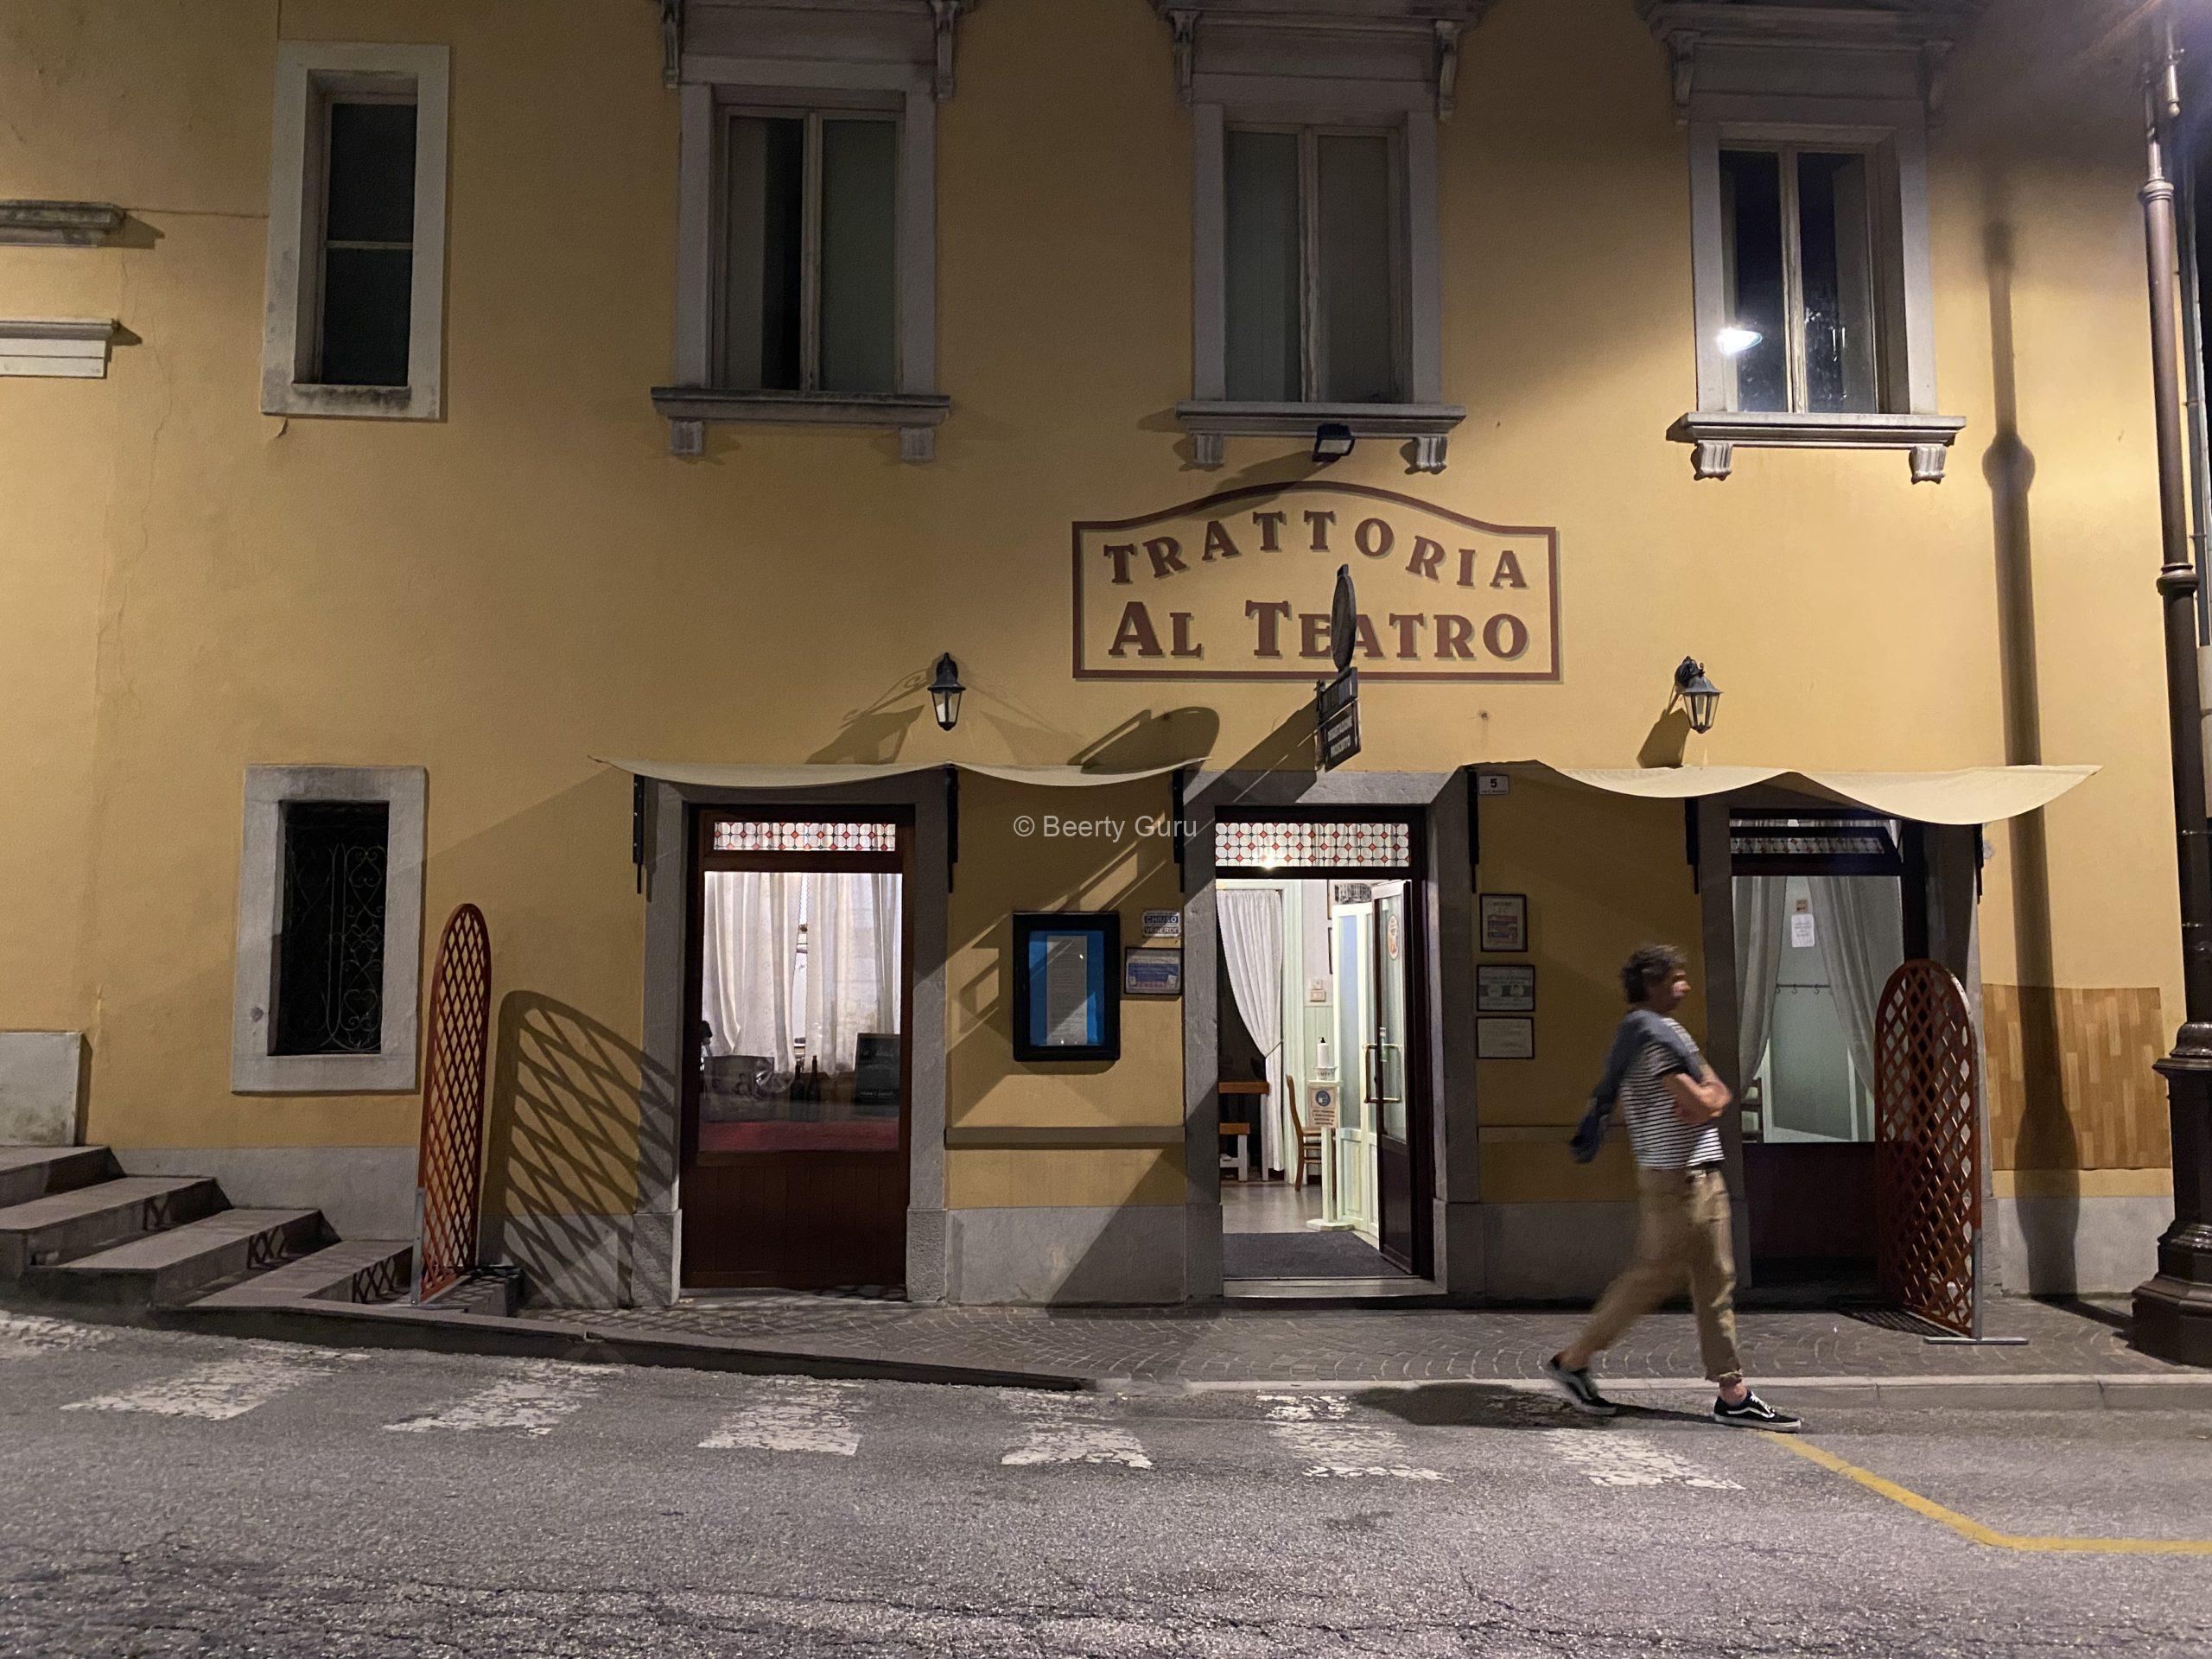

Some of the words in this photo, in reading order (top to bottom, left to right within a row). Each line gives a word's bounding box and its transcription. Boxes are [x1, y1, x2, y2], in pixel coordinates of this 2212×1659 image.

[1103, 510, 1527, 588] TRATTORIA
[1108, 601, 1202, 659] AL
[1244, 600, 1529, 659] TEATRO
[1490, 779, 1497, 788] 5
